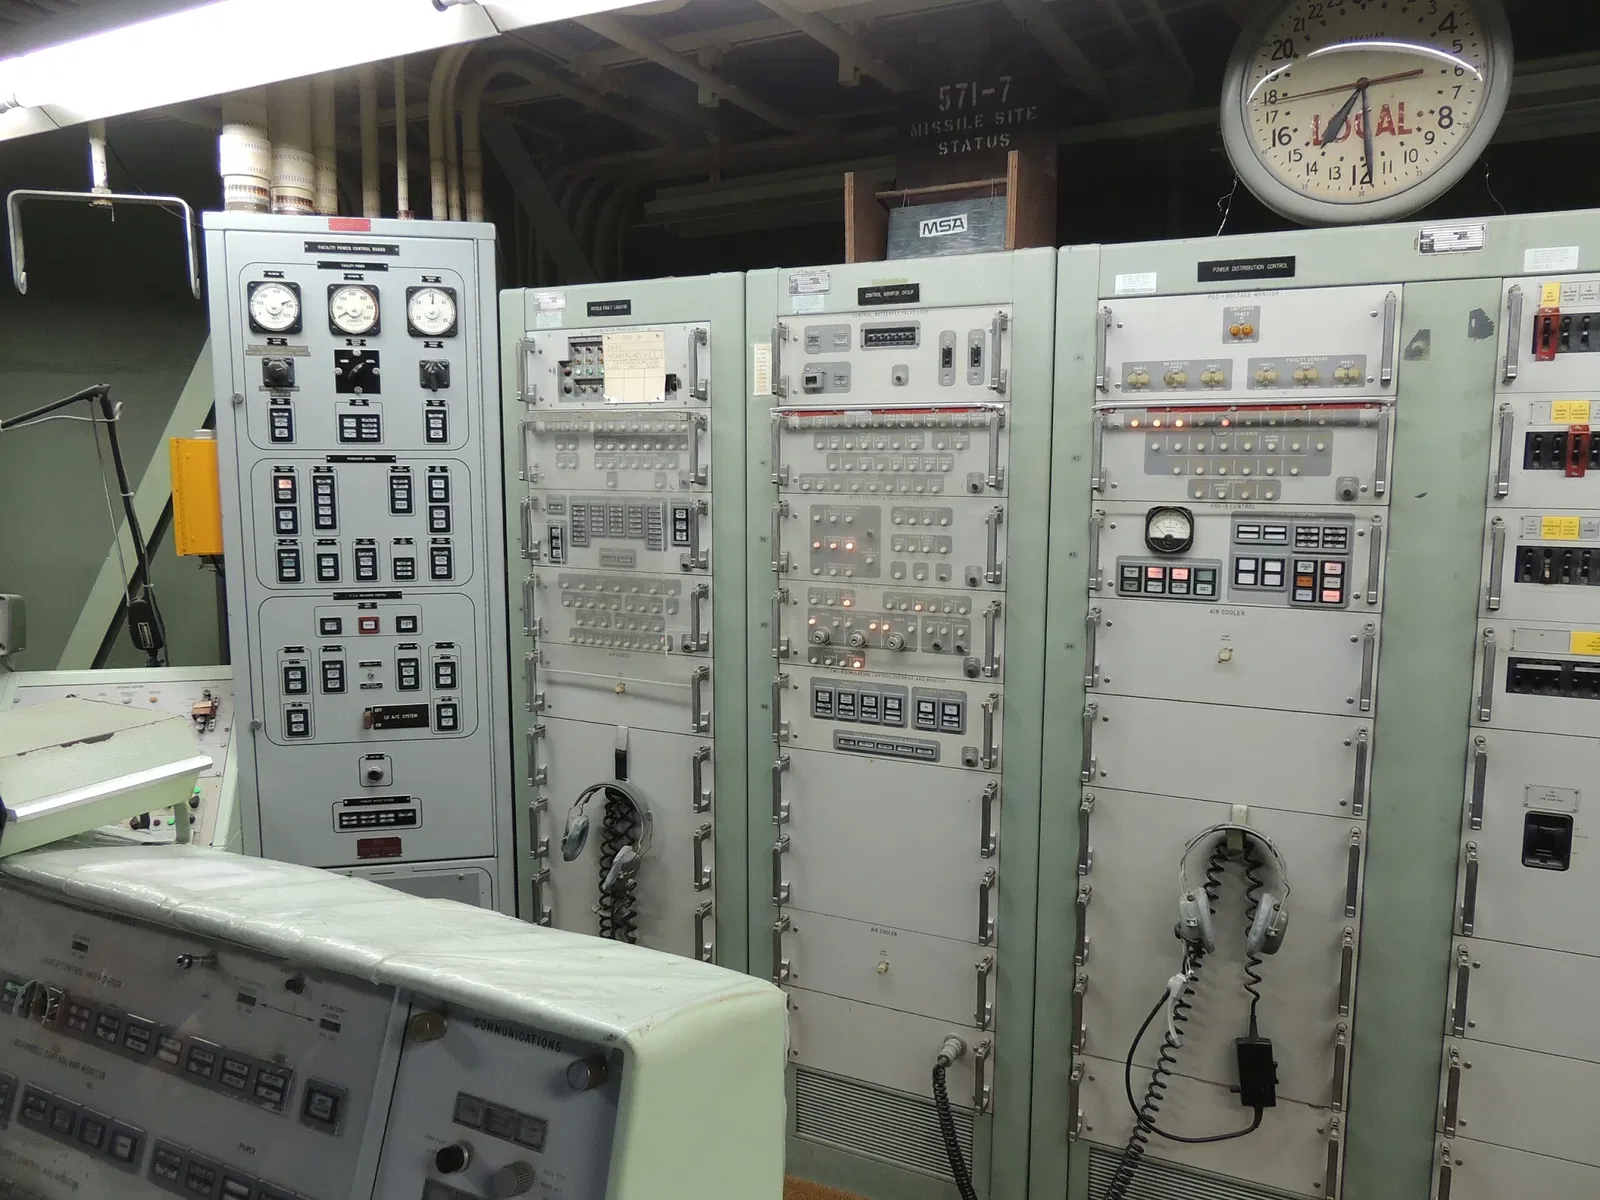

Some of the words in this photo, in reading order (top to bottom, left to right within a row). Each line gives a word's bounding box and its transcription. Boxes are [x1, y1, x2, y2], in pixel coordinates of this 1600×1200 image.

[1308, 4, 1324, 19] 22
[1293, 17, 1305, 32] 21
[1438, 10, 1458, 34] 4
[1271, 38, 1294, 61] 20
[1452, 39, 1463, 54] 5
[1454, 65, 1464, 77] 6
[938, 76, 1012, 112] 571-7
[1263, 89, 1278, 106] 18
[1452, 86, 1462, 100] 7
[910, 114, 984, 138] MISSILE
[994, 105, 1037, 125] SITE
[1265, 110, 1279, 124] 17
[1312, 101, 1413, 147] LOCAL
[1438, 105, 1453, 129] 8
[938, 133, 1011, 156] STATUS
[1271, 126, 1293, 148] 16
[1424, 131, 1435, 145] 9
[1288, 148, 1303, 163] 15
[1403, 148, 1419, 164] 10
[1306, 160, 1319, 176] 14
[1328, 166, 1342, 181] 13
[1351, 163, 1373, 186] 12
[1382, 160, 1393, 174] 11
[922, 216, 965, 236] MSA
[1231, 264, 1265, 272] DISTRIBUTION
[1266, 262, 1289, 270] CONTROL
[474, 1017, 562, 1053] COMMUNICATIONS
